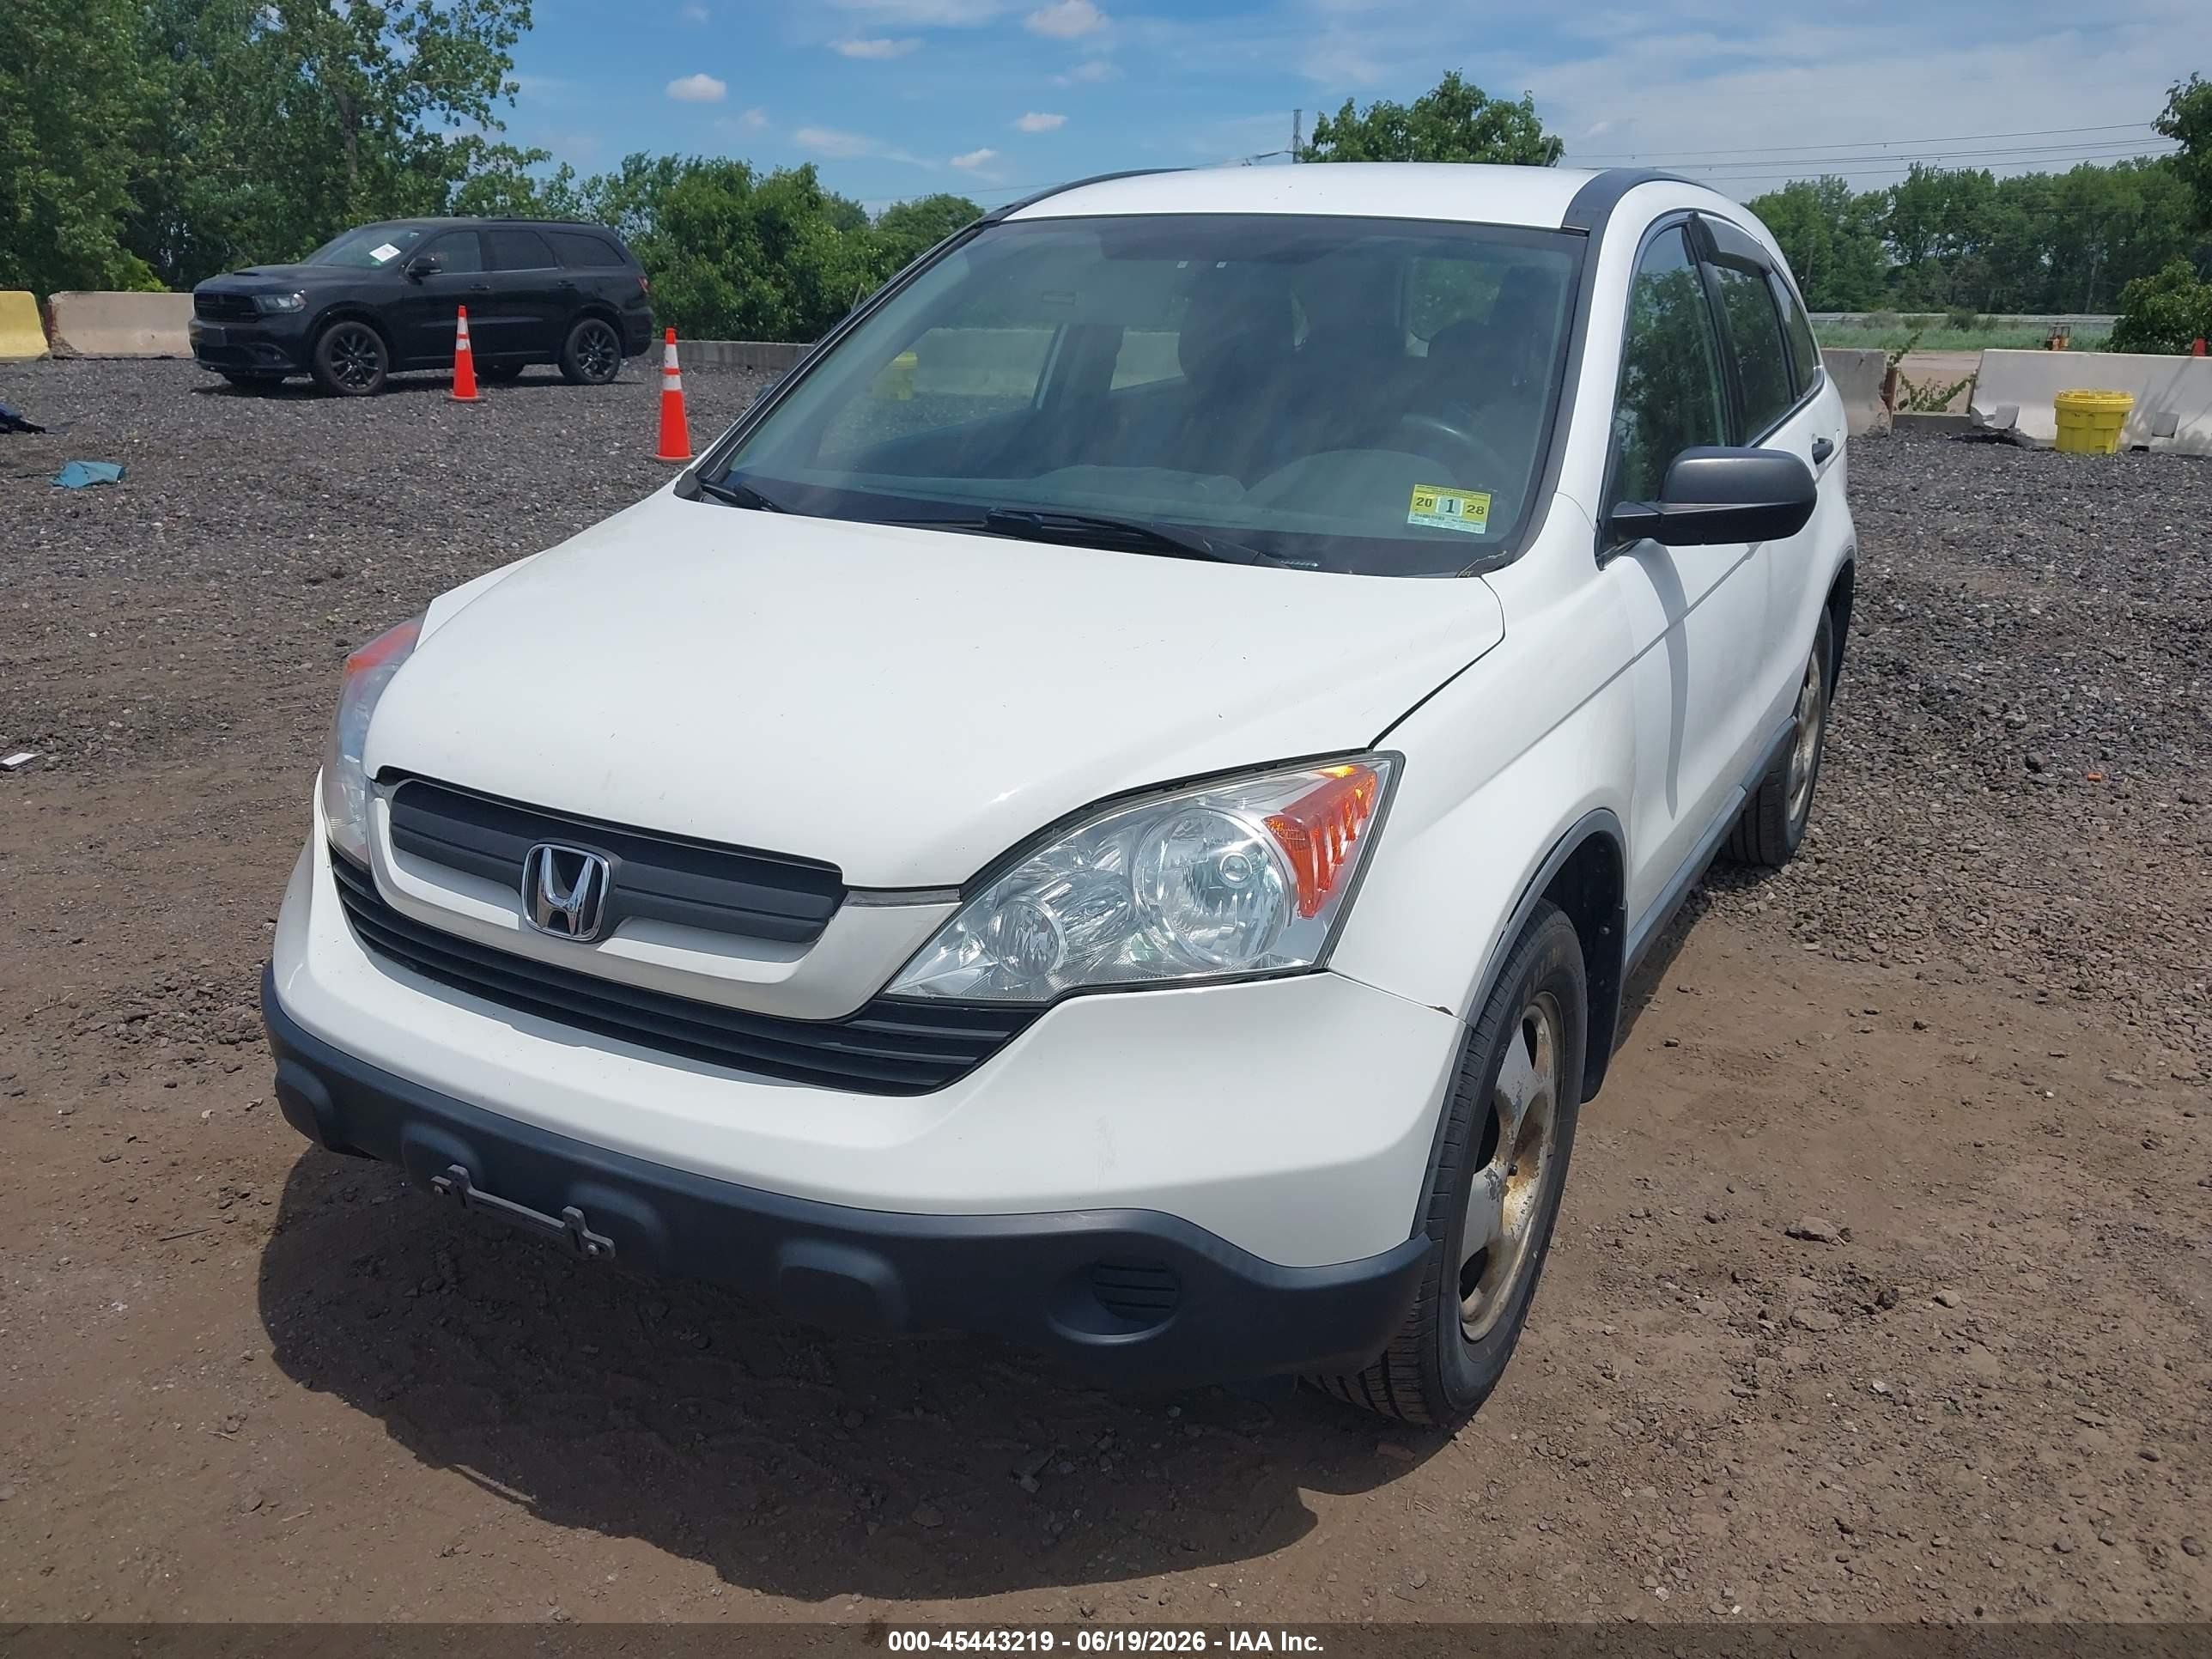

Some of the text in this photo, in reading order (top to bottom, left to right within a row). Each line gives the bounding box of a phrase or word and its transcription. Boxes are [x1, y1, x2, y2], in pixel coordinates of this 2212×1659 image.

[1416, 497, 1485, 515] 20 1 28
